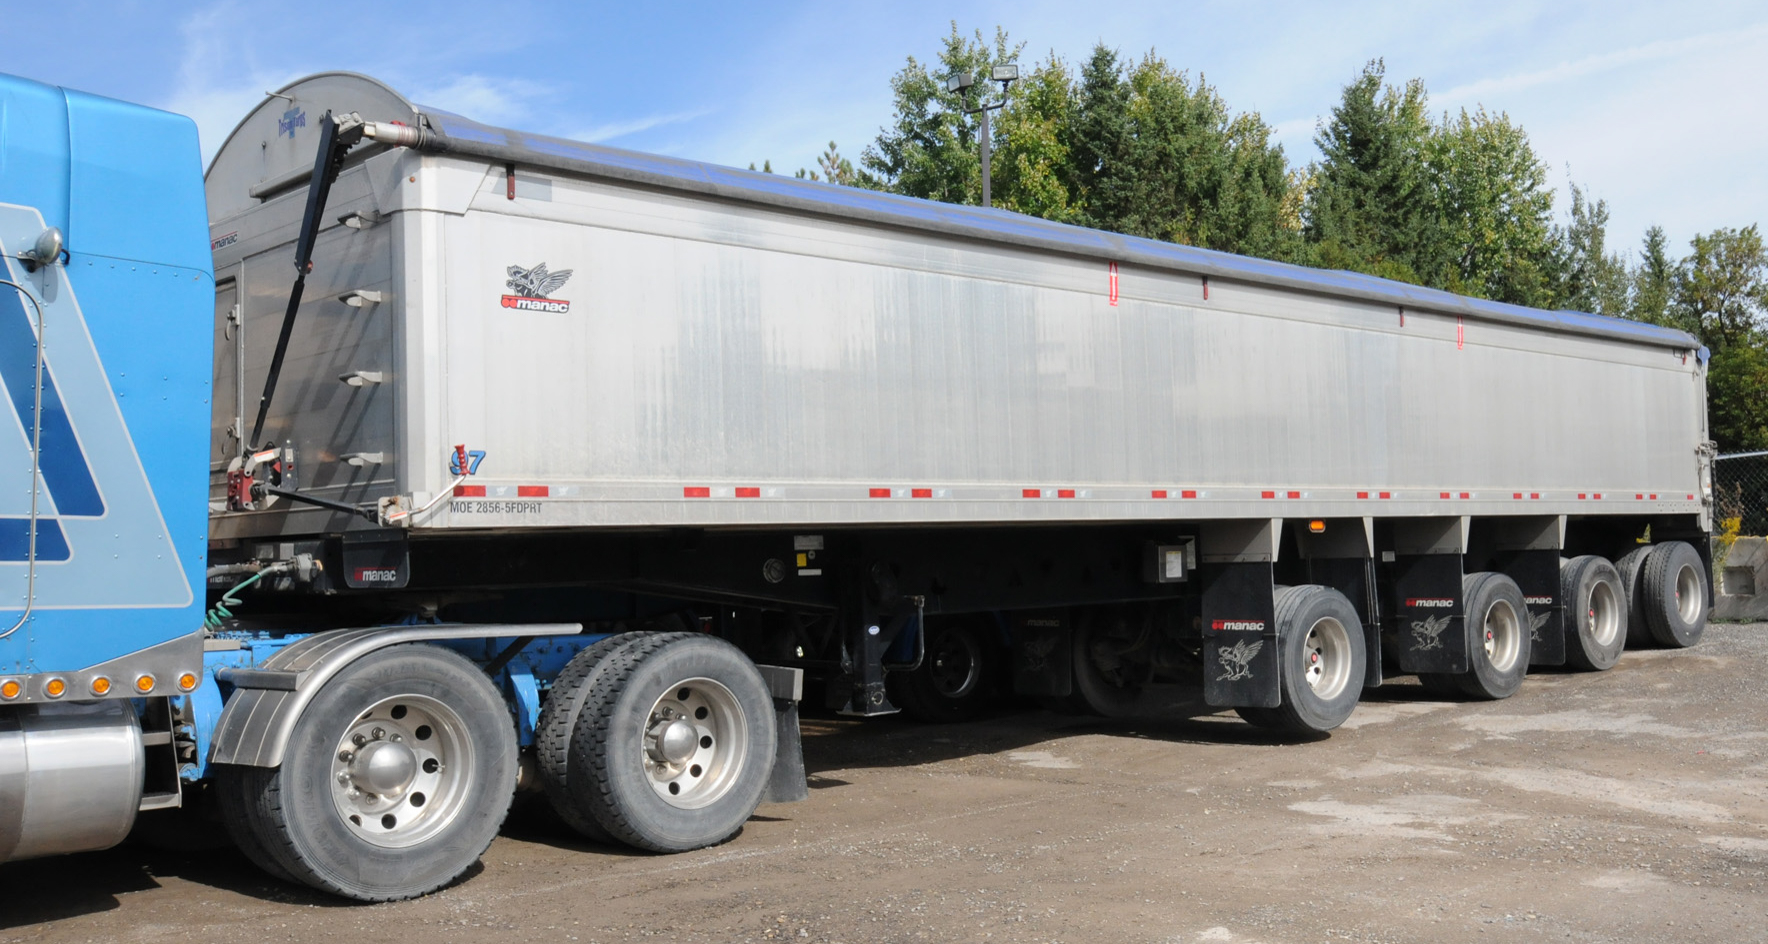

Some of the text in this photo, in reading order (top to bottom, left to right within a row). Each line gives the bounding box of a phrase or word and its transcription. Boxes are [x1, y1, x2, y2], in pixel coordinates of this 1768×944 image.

[214, 233, 238, 250] manac
[516, 299, 569, 313] manac
[449, 450, 486, 475] 97
[450, 501, 543, 514] MOE 2856-5FDPRT
[362, 569, 397, 582] manac
[1415, 599, 1454, 608] manac
[1223, 621, 1265, 631] manac
